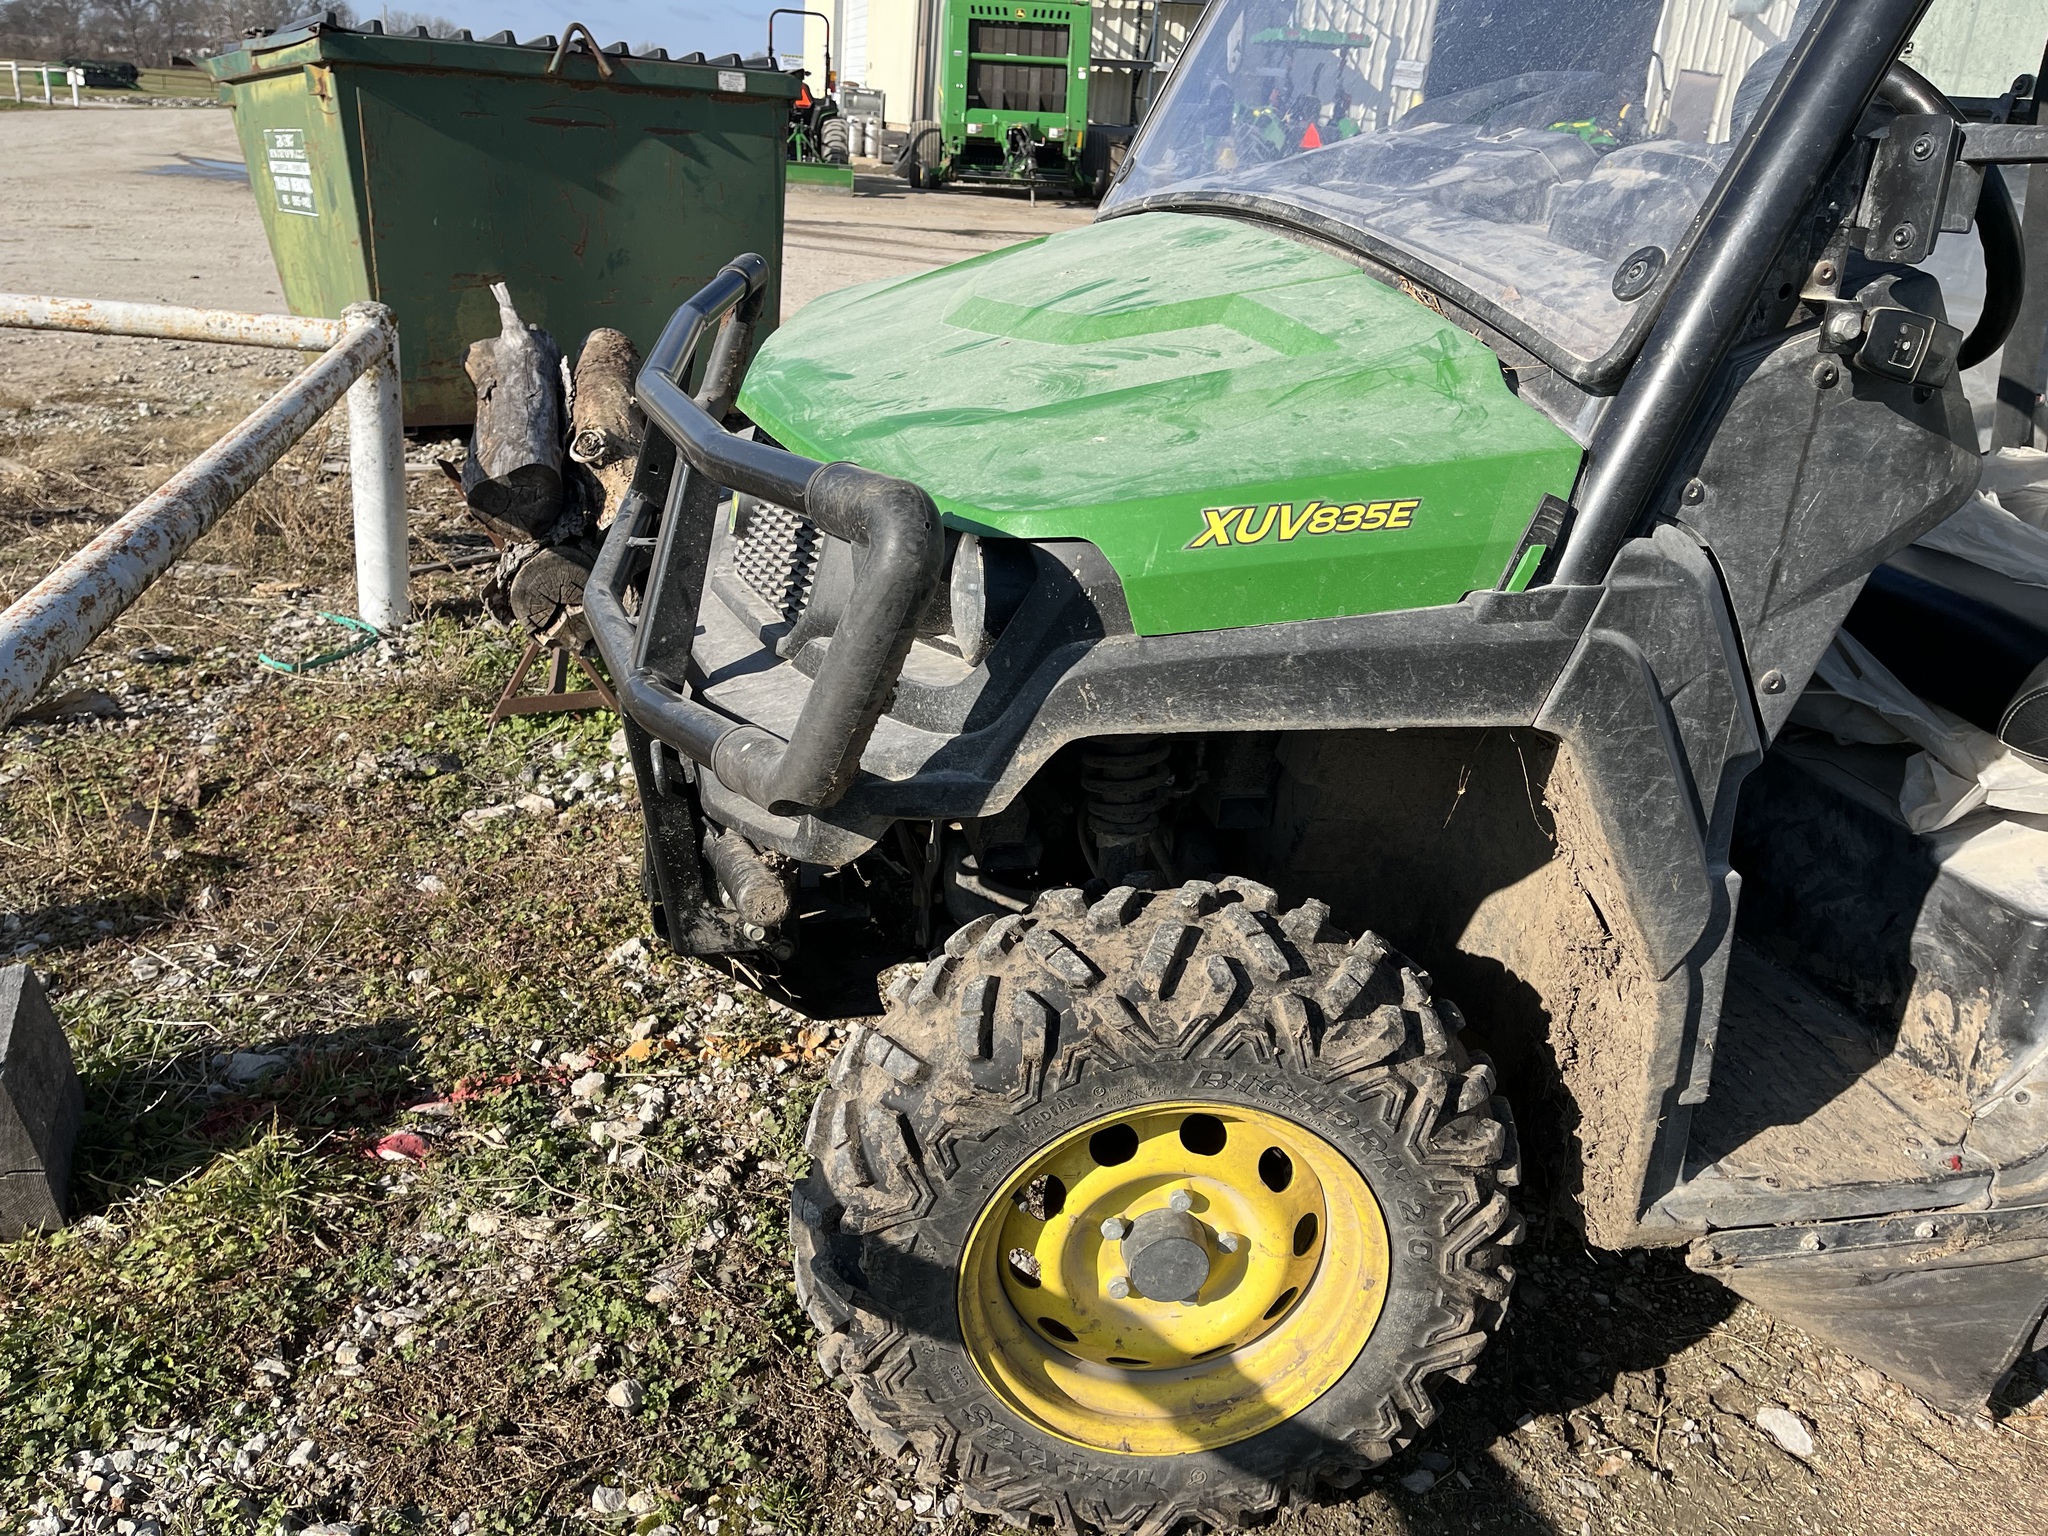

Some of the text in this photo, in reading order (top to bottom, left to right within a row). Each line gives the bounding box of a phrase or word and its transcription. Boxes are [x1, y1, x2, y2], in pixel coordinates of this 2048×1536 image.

[1185, 498, 1422, 549] XUV835E
[971, 1140, 1009, 1176] NYLON
[1018, 1096, 1078, 1134] RADIAL
[1191, 1070, 1412, 1182] BIGHORN
